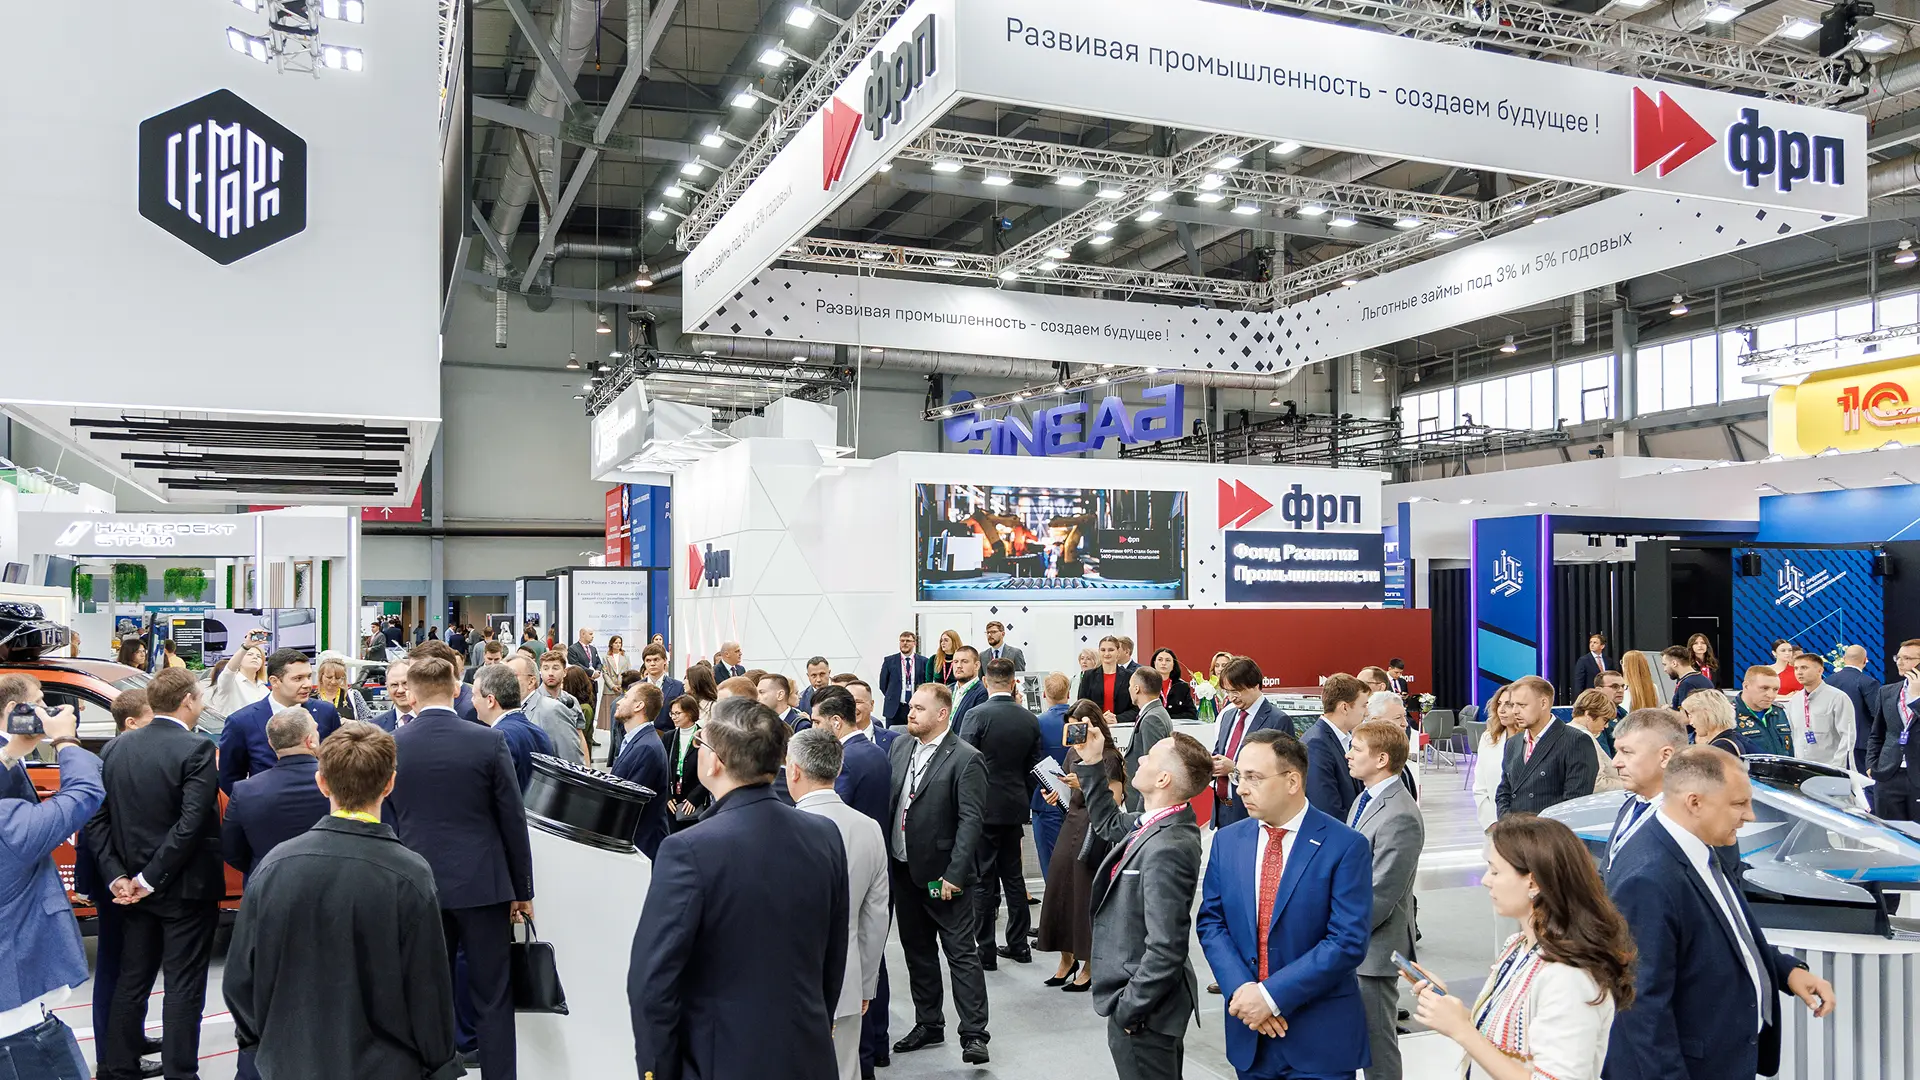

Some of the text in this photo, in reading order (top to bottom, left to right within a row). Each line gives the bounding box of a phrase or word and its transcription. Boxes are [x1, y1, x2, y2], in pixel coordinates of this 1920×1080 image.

[1006, 17, 1138, 63] Развивая
[1150, 46, 1370, 99] промышленность
[1395, 87, 1490, 118] создаем
[1498, 98, 1588, 133] будущее
[1595, 113, 1600, 135] !
[1361, 231, 1633, 322] Льготные займы под 3% и 5% годовых
[816, 299, 890, 319] Развивая
[895, 308, 1026, 330] промышленность
[1040, 319, 1100, 338] создаем
[1104, 324, 1162, 342] будущее
[1233, 543, 1360, 563] Фонд Развития
[1233, 565, 1381, 584] Промышленности
